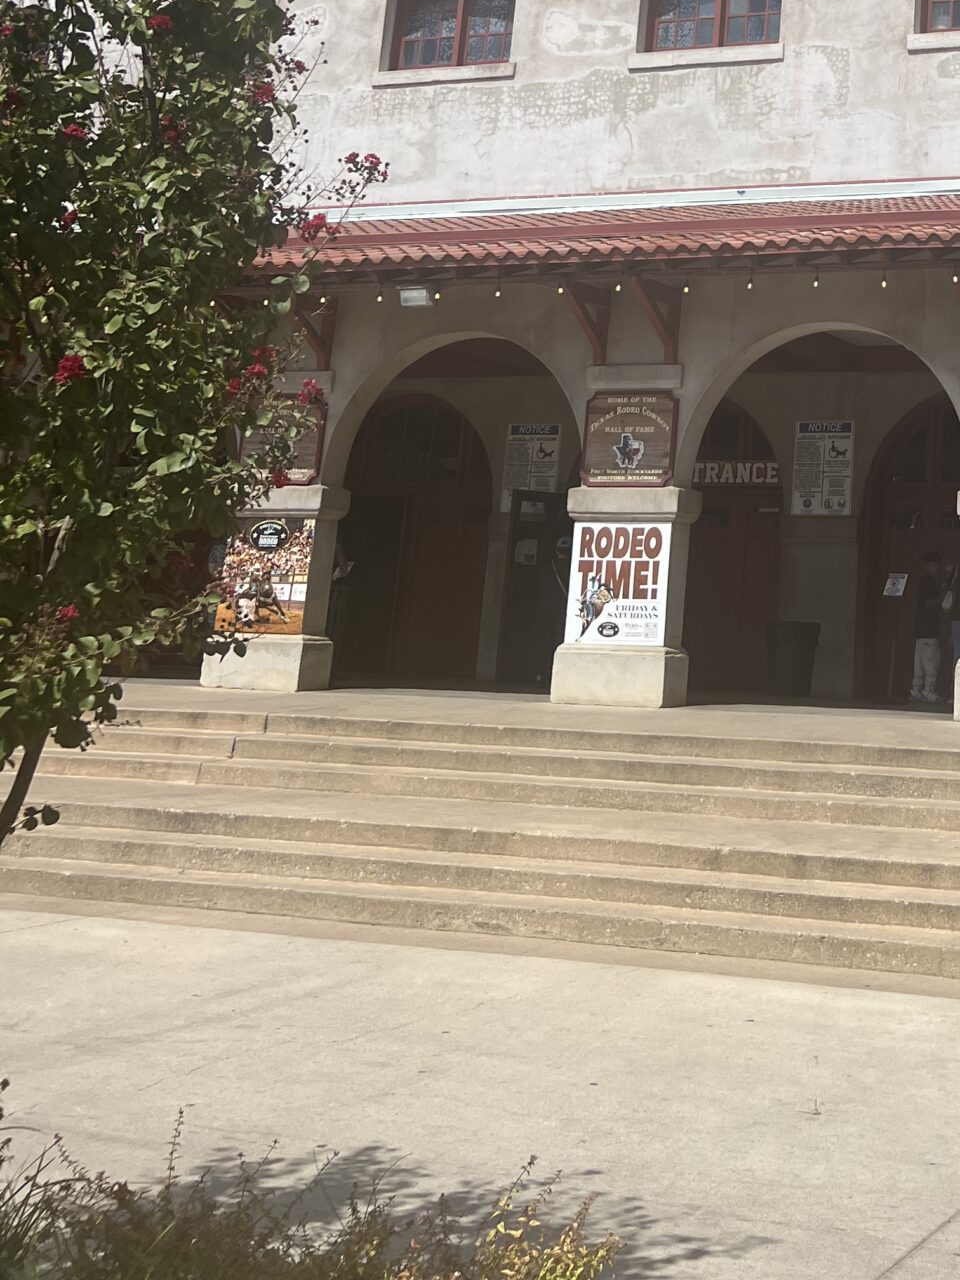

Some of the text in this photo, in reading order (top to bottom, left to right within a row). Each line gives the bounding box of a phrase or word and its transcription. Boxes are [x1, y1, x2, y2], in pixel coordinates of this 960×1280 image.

[520, 426, 551, 434] NOTICE
[590, 406, 670, 432] TEXAS RODEO COWBOY
[808, 423, 842, 432] NOTICE
[693, 462, 780, 484] TRANCE
[579, 526, 663, 559] RODEO
[578, 560, 661, 600] TIME!
[616, 604, 658, 612] FRIDAY &
